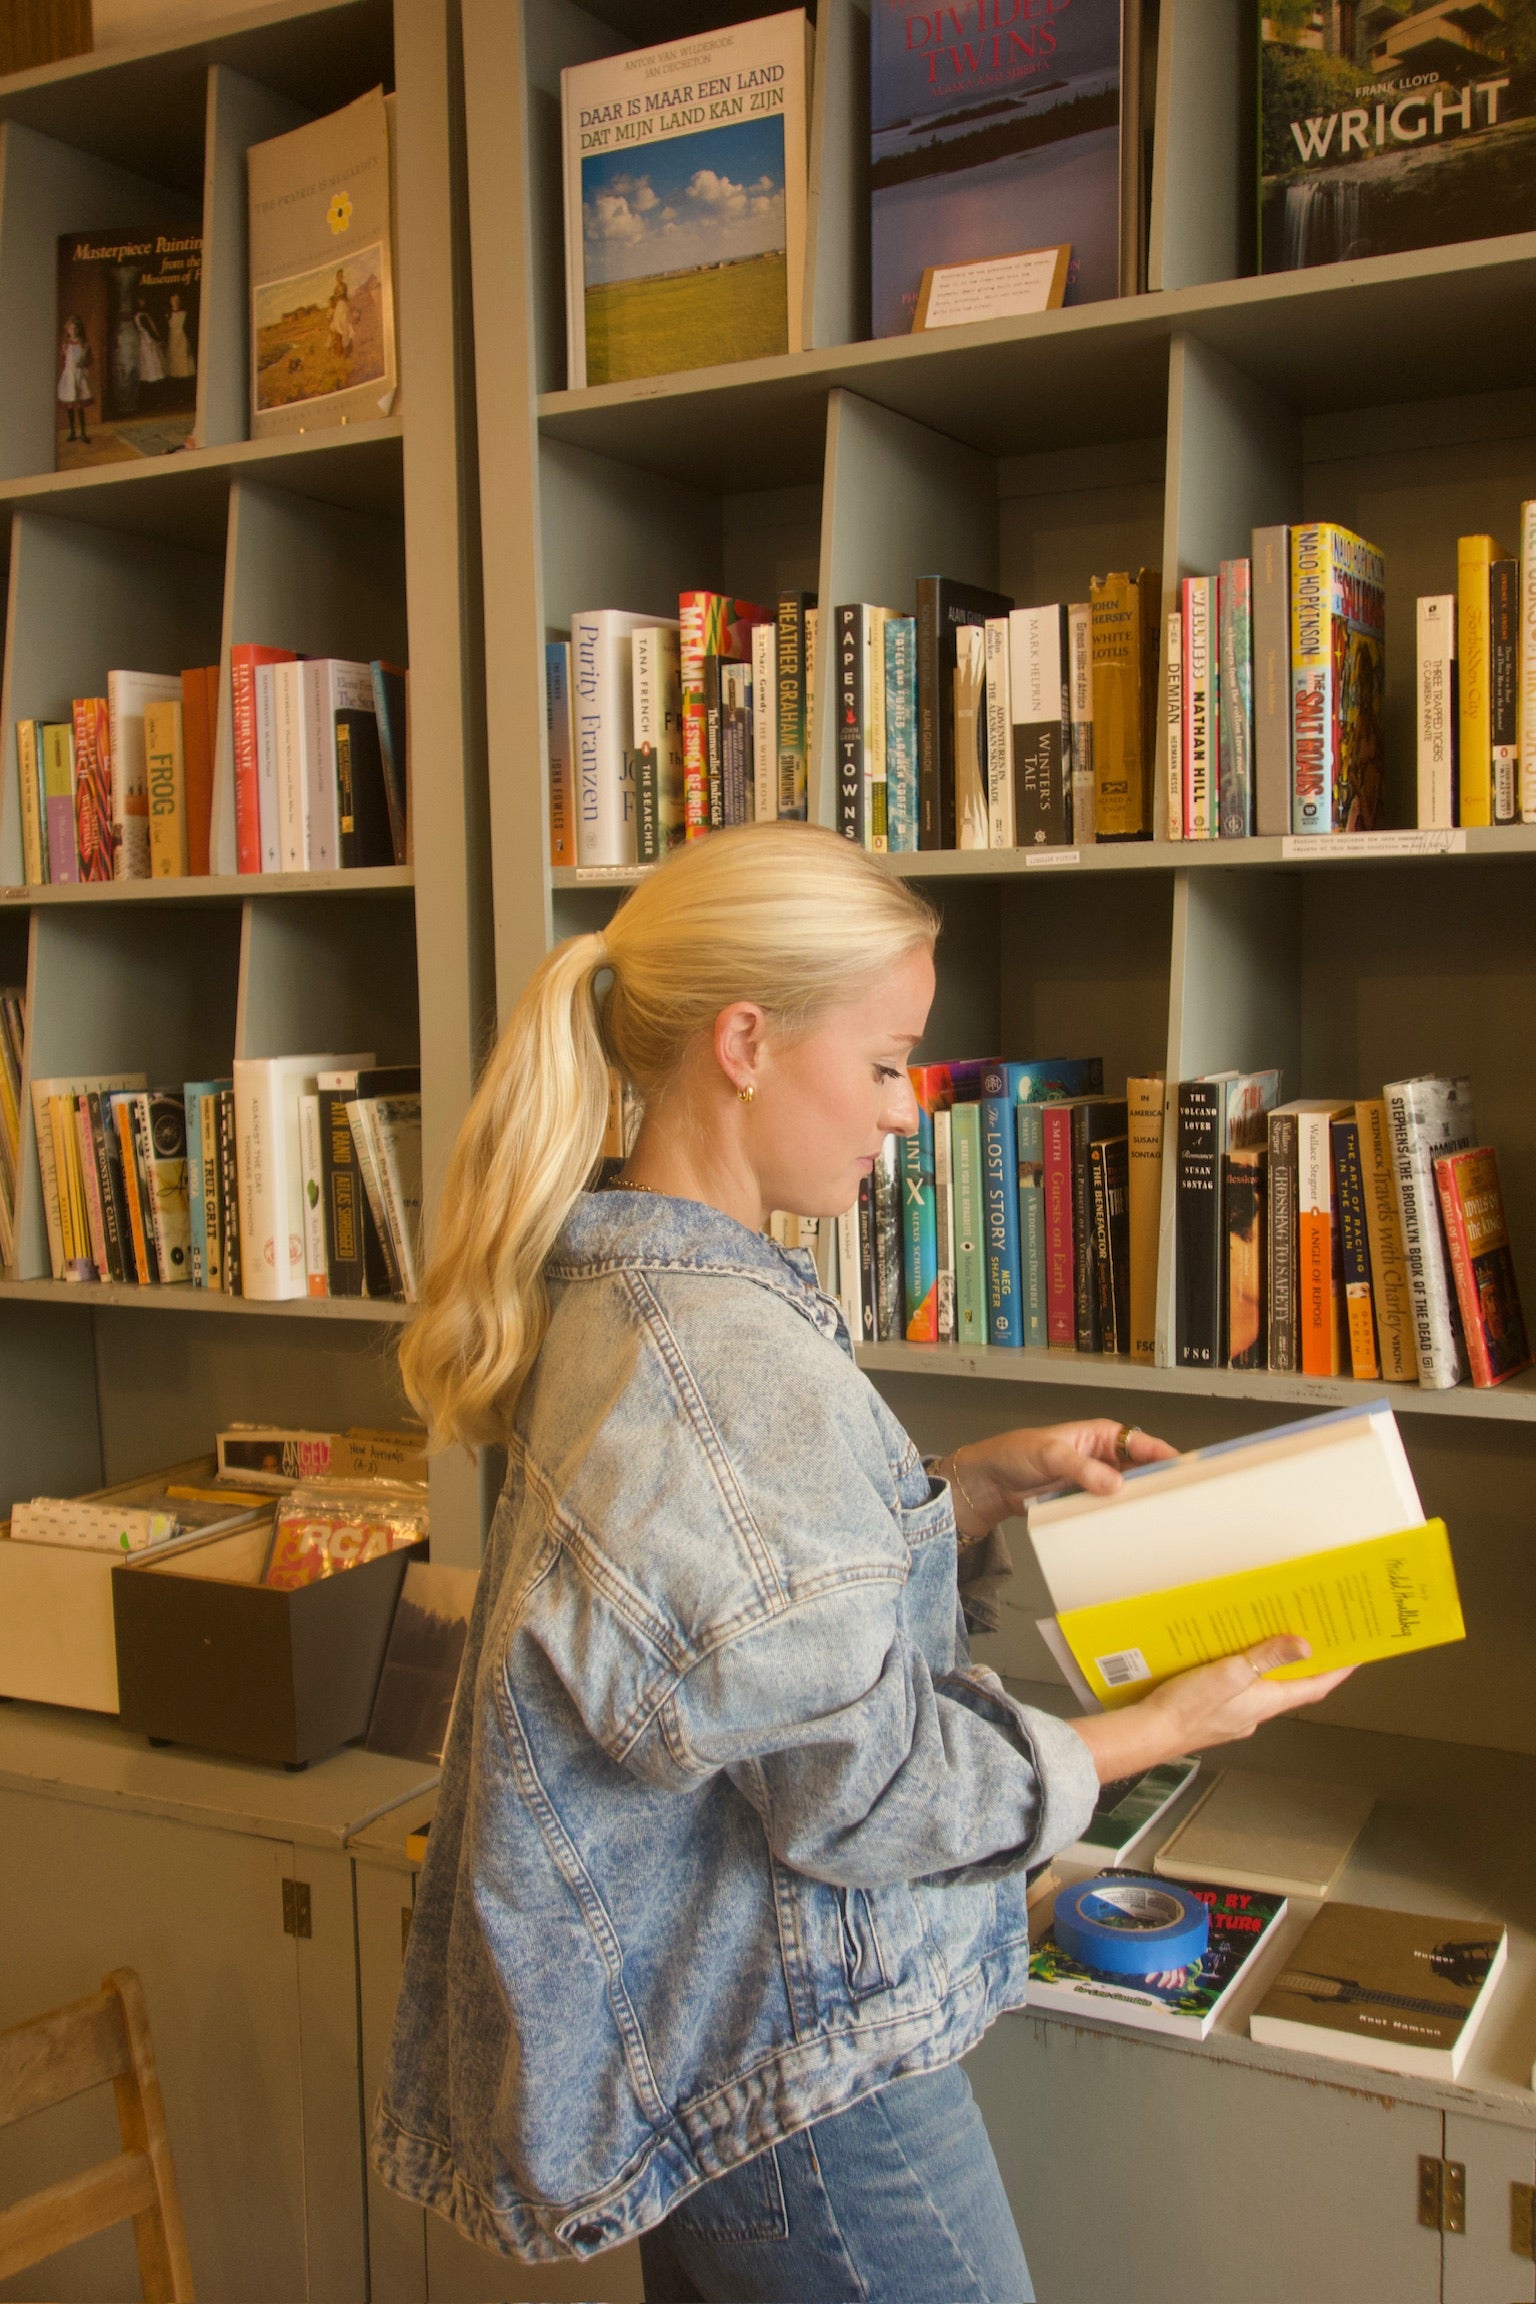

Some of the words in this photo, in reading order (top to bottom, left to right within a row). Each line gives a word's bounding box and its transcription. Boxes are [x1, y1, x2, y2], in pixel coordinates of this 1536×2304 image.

[919, 20, 1057, 83] TWINS
[580, 105, 623, 128] DAAR
[627, 99, 641, 116] IS
[645, 85, 694, 112] MAAR
[698, 77, 731, 99] EEN
[737, 64, 785, 90] LAND
[1355, 80, 1394, 97] FRANK
[1400, 72, 1439, 89] LLOYD
[581, 128, 610, 149] DAT
[615, 118, 653, 141] MIJN
[660, 106, 705, 131] LAND
[709, 96, 744, 120] KAN
[750, 87, 785, 112] ZIJN
[1290, 78, 1510, 162] WRIGHT
[72, 242, 152, 263] Masterpiece
[1299, 531, 1319, 570] NALO
[1191, 590, 1206, 679] WELLNESS
[1299, 575, 1320, 656] HOPKINSON
[639, 638, 648, 675] TANA
[679, 606, 704, 694] MAAME
[779, 601, 798, 674] HEATHER
[987, 625, 995, 659] Hawkes
[994, 630, 1002, 653] John
[1029, 618, 1039, 658] MARK
[1092, 631, 1133, 644] WHITE
[1092, 647, 1129, 659] LOTUS
[576, 625, 600, 702] Purity
[843, 611, 854, 706] PAPER
[1432, 659, 1443, 687] THREE
[240, 664, 249, 704] ELENA
[988, 682, 996, 701] THE
[1031, 663, 1041, 711] HELPRIN
[1167, 663, 1180, 724] DEMIAN
[1314, 673, 1325, 691] THE
[1423, 669, 1432, 706] CABRERA
[640, 682, 649, 733] FRENCH
[708, 708, 718, 724] The
[780, 679, 799, 747] GRAHAM
[1295, 690, 1325, 734] SALT
[1432, 690, 1443, 729] TRAPPED
[1463, 689, 1481, 719] City
[76, 706, 88, 779] ERDRICH
[241, 706, 252, 768] FERRANTE
[686, 713, 702, 768] JESSICA
[989, 704, 998, 746] ALASKAN
[997, 705, 1006, 768] ADVENTURES
[1192, 691, 1206, 760] NATHAN
[1424, 708, 1433, 741] INFANTE
[708, 725, 719, 774] Immoralist
[989, 750, 998, 772] SKIN
[1170, 735, 1178, 769] HERMANN
[1432, 731, 1444, 762] TIGERS
[150, 753, 175, 817] FROG
[551, 758, 562, 783] JOHN
[581, 714, 601, 821] Franzen
[643, 764, 651, 785] THE
[780, 754, 794, 806] SUMMONING
[998, 770, 1006, 781] IN
[1024, 754, 1037, 792] TALE
[1038, 732, 1051, 810] WINTER'S
[1170, 772, 1178, 794] HESSE
[1192, 767, 1206, 803] HILL
[1295, 739, 1325, 797] ROADS
[687, 774, 703, 825] GEORGE
[710, 778, 721, 805] André
[842, 743, 858, 839] TOWNS
[990, 773, 999, 805] TRADE
[552, 788, 564, 829] FOWLES
[643, 789, 653, 855] SEARCHER
[711, 806, 721, 825] Gide
[331, 1101, 349, 1126] AYN
[987, 1105, 999, 1128] The
[1180, 1107, 1217, 1117] VOLCANO
[1190, 1094, 1206, 1102] THE
[252, 1099, 260, 1144] AGAINST
[1052, 1119, 1062, 1161] SMITH
[1184, 1121, 1211, 1131] LOVER
[1272, 1120, 1282, 1155] Stegner
[1282, 1121, 1290, 1153] Wallace
[1369, 1109, 1384, 1169] STEINBECK
[1391, 1097, 1409, 1154] STEPHENS
[244, 1135, 252, 1179] THOMAS
[253, 1150, 261, 1168] THE
[332, 1130, 351, 1164] RAND
[987, 1132, 1002, 1181] LOST
[1310, 1123, 1320, 1162] Wallace
[1347, 1134, 1355, 1159] THE
[204, 1158, 215, 1197] TRUE
[379, 1158, 388, 1176] the
[1093, 1165, 1101, 1187] THE
[1184, 1166, 1211, 1175] SUSAN
[1308, 1164, 1319, 1200] Stegner
[1339, 1159, 1347, 1169] IN
[1349, 1165, 1358, 1191] ART
[1399, 1161, 1412, 1181] THE
[98, 1148, 110, 1202] MONSTER
[105, 1206, 117, 1242] CALLS
[254, 1173, 262, 1195] DAY
[336, 1175, 351, 1205] ATLAS
[383, 1178, 394, 1213] green
[1052, 1171, 1064, 1225] Guests
[1182, 1181, 1213, 1190] SONTAG
[1275, 1166, 1289, 1240] CROSSING
[1341, 1181, 1350, 1207] THE
[1375, 1171, 1394, 1221] Travels
[206, 1202, 217, 1240] GRIT
[246, 1185, 254, 1236] PYNCHON
[989, 1189, 1005, 1251] STORY
[1351, 1197, 1360, 1213] OF
[1401, 1185, 1420, 1244] BROOKLYN
[336, 1207, 354, 1256] SHRUGGED
[861, 1210, 869, 1241] James
[911, 1210, 920, 1242] ALEXIS
[1053, 1228, 1062, 1247] on
[1094, 1190, 1107, 1259] BENEFACTOR
[1343, 1215, 1353, 1250] RAIN
[862, 1243, 870, 1270] Sallis
[1275, 1244, 1289, 1257] TO
[1311, 1227, 1321, 1265] ANGLE
[1354, 1218, 1365, 1273] RACING
[1379, 1227, 1398, 1266] with
[1408, 1248, 1424, 1278] BOOK
[912, 1246, 921, 1297] SCHAITKIN
[991, 1256, 1001, 1308] SHAFFER
[1001, 1269, 1011, 1295] MEG
[1053, 1252, 1065, 1295] Earth
[1312, 1268, 1322, 1282] OF
[1413, 1281, 1425, 1296] OF
[1275, 1265, 1290, 1322] SAFETY
[1313, 1286, 1322, 1329] REPOSE
[1378, 1269, 1405, 1333] Charley
[1415, 1299, 1428, 1318] THE
[1352, 1313, 1361, 1353] STEIN
[1361, 1310, 1370, 1355] GARTH
[1418, 1322, 1432, 1351] DEAD
[1392, 1334, 1403, 1373] VIKING
[299, 1524, 390, 1563] RCA
[1224, 1893, 1252, 1909] BY
[1413, 1950, 1455, 1964] Hunger
[1359, 2014, 1387, 2026] Knut
[1393, 2021, 1441, 2036] Hamsun
